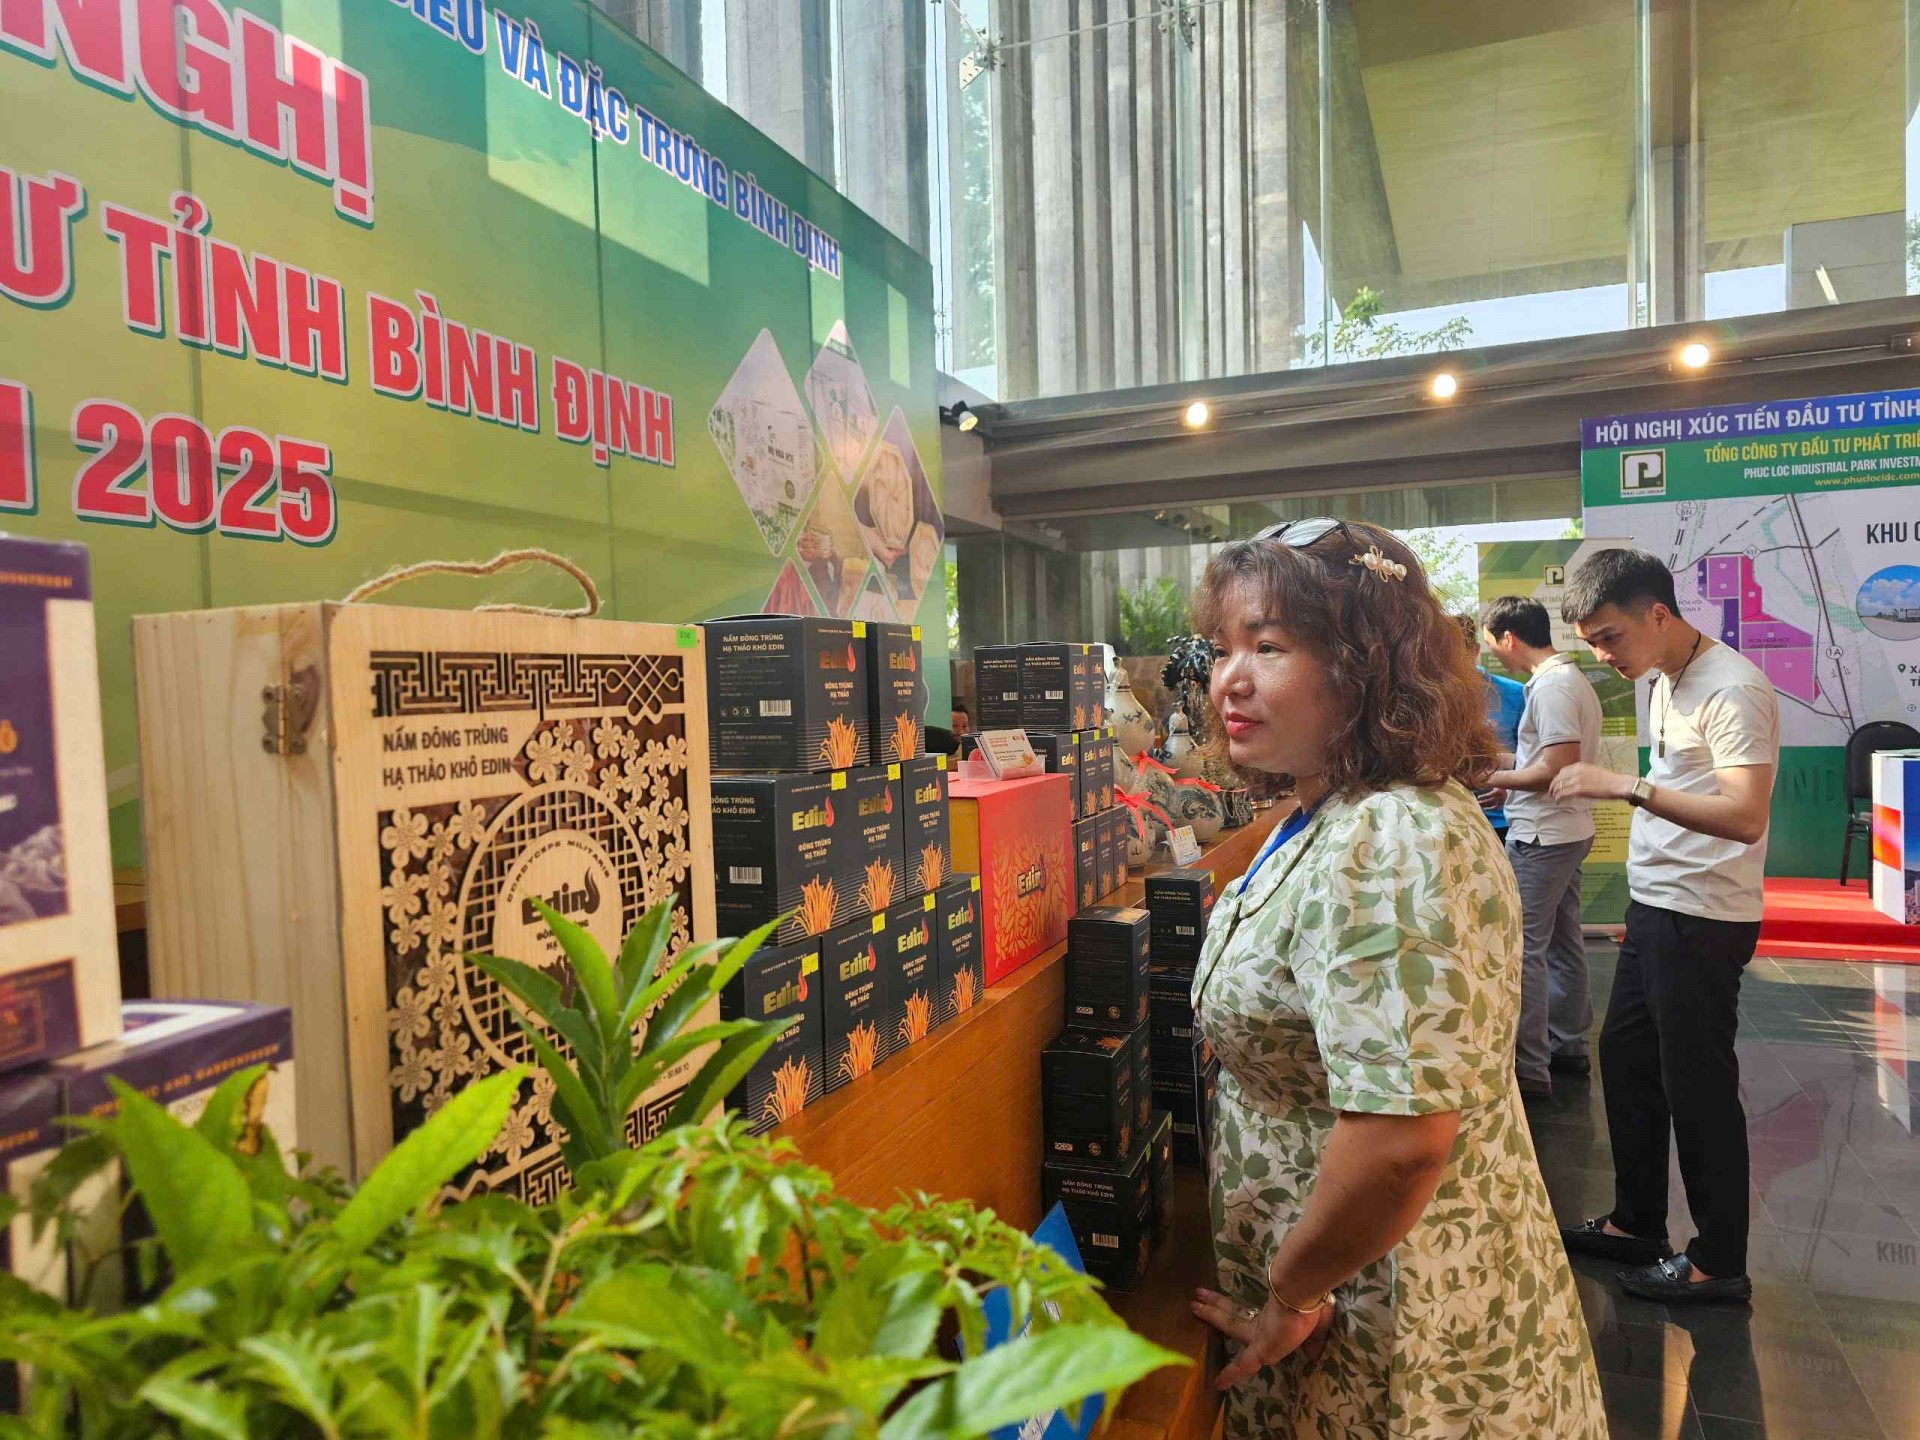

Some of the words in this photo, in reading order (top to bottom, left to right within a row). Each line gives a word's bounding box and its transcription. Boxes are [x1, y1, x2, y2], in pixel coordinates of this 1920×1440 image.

[494, 8, 552, 99] VÀ
[557, 51, 629, 145] ĐẶC
[635, 104, 728, 209] TRƯNG
[734, 171, 788, 248] BÌNH
[794, 211, 840, 279] ĐỊNH
[103, 190, 346, 382] TỈNH
[366, 290, 539, 431] BÌNH
[551, 356, 675, 466] ĐỊNH
[1596, 420, 1628, 445] HỘI
[1635, 419, 1682, 440] NGHỊ
[1688, 412, 1729, 436] XÚC
[1734, 404, 1780, 432] TIẾN
[1786, 402, 1830, 427] ĐẦU
[1836, 401, 1865, 423] TƯ
[1870, 396, 1920, 420] TỈNH
[1704, 442, 1738, 463] TỔNG
[1742, 442, 1777, 460] CÔNG
[1781, 442, 1798, 457] TY
[1801, 436, 1828, 456] ĐẦU
[1832, 437, 1850, 453] TƯ
[1854, 432, 1890, 452] PHÁT
[71, 399, 335, 544] 2025
[1743, 467, 1769, 479] PHUC
[1771, 465, 1790, 477] LOC
[1791, 461, 1848, 476] INDUSTRIAL
[1851, 459, 1877, 471] PARK
[1867, 522, 1907, 544] KHU
[723, 633, 739, 642] NẤM
[740, 633, 760, 642] ĐÔNG
[761, 633, 784, 641] TRÙNG
[723, 645, 733, 653] HẠ
[753, 643, 767, 651] KHÔ
[383, 725, 417, 752] NẤM
[421, 725, 461, 749] ĐÔNG
[464, 723, 508, 746] TRÙNG
[383, 767, 404, 791] HẠ
[408, 758, 446, 783] THẢO
[450, 755, 478, 779] KHÔ
[481, 757, 511, 776] EDIN
[731, 796, 754, 804] TRÙNG
[792, 804, 834, 831] Edin
[567, 840, 610, 878] MILITARIS
[948, 906, 973, 930] Edin
[898, 926, 929, 953] Edin
[840, 952, 876, 981] Edin
[764, 980, 807, 1014] Edin
